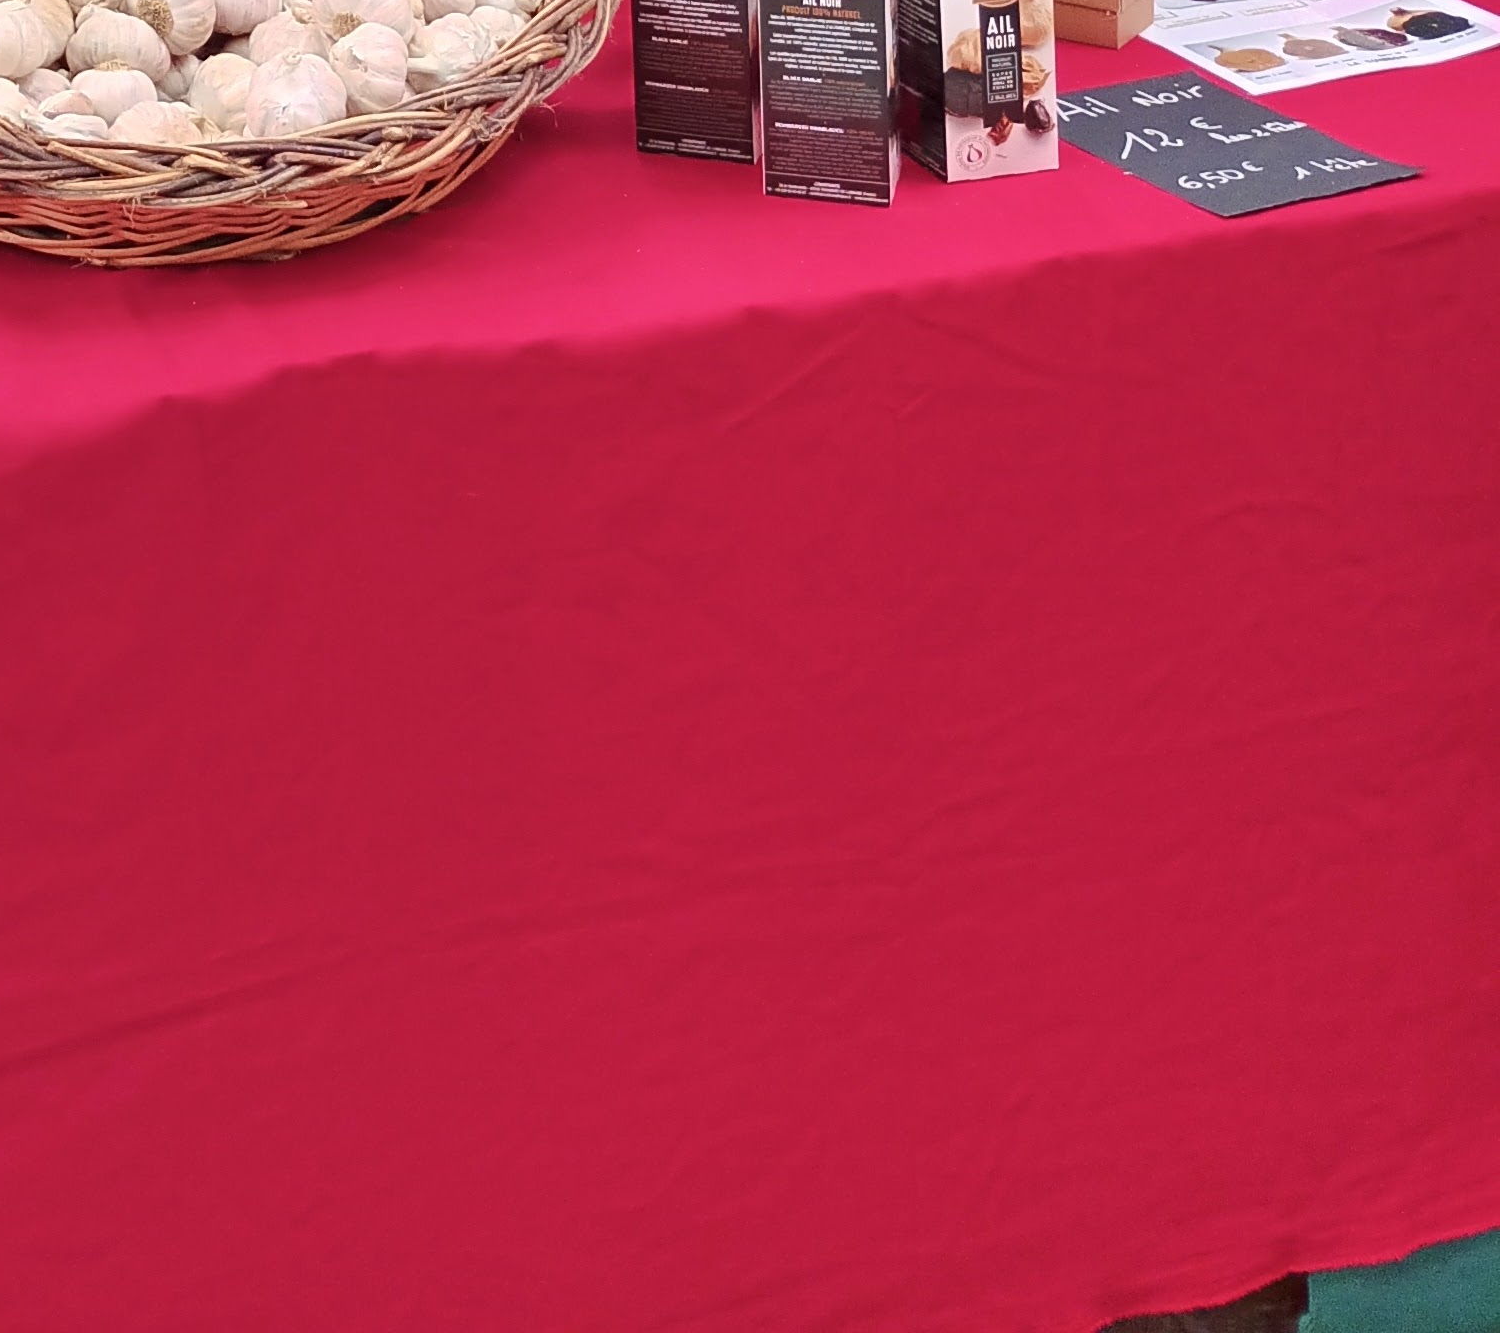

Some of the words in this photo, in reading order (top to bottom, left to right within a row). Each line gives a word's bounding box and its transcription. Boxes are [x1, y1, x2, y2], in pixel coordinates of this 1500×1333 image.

[987, 15, 1014, 35] AIL
[986, 34, 1016, 50] NOIR
[1131, 83, 1206, 108] Noir
[1120, 128, 1185, 160] 12
